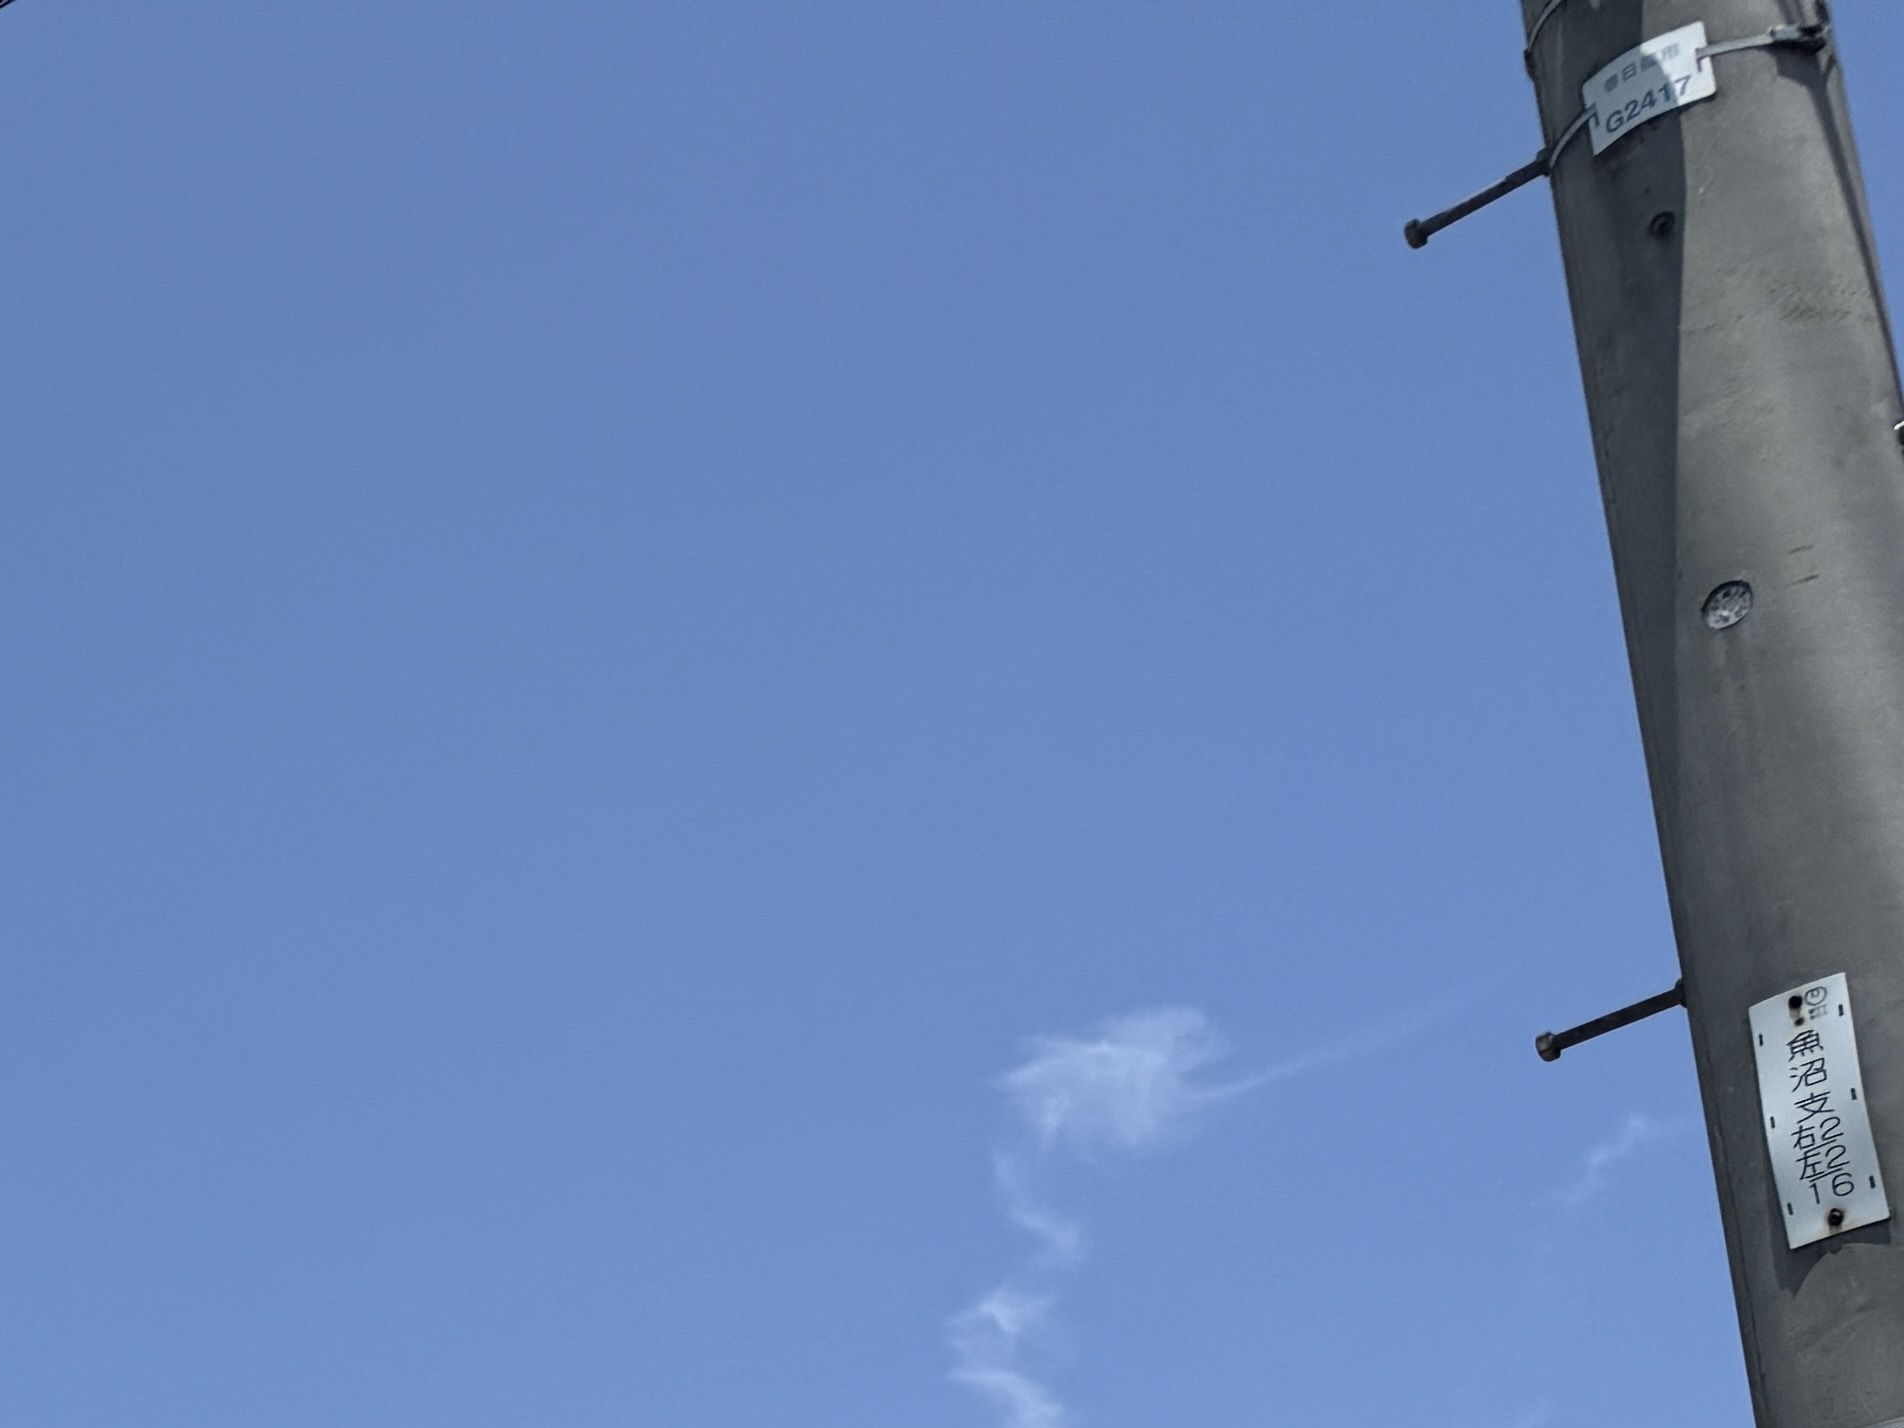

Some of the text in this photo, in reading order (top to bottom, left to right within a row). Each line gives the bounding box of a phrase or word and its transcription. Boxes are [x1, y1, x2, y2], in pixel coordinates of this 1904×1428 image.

[1606, 75, 1691, 133] G2417
[1786, 1029, 1835, 1124] 魚沼支
[1791, 1116, 1844, 1150] 右2
[1796, 1144, 1850, 1181] 左2
[1809, 1172, 1855, 1205] 16
